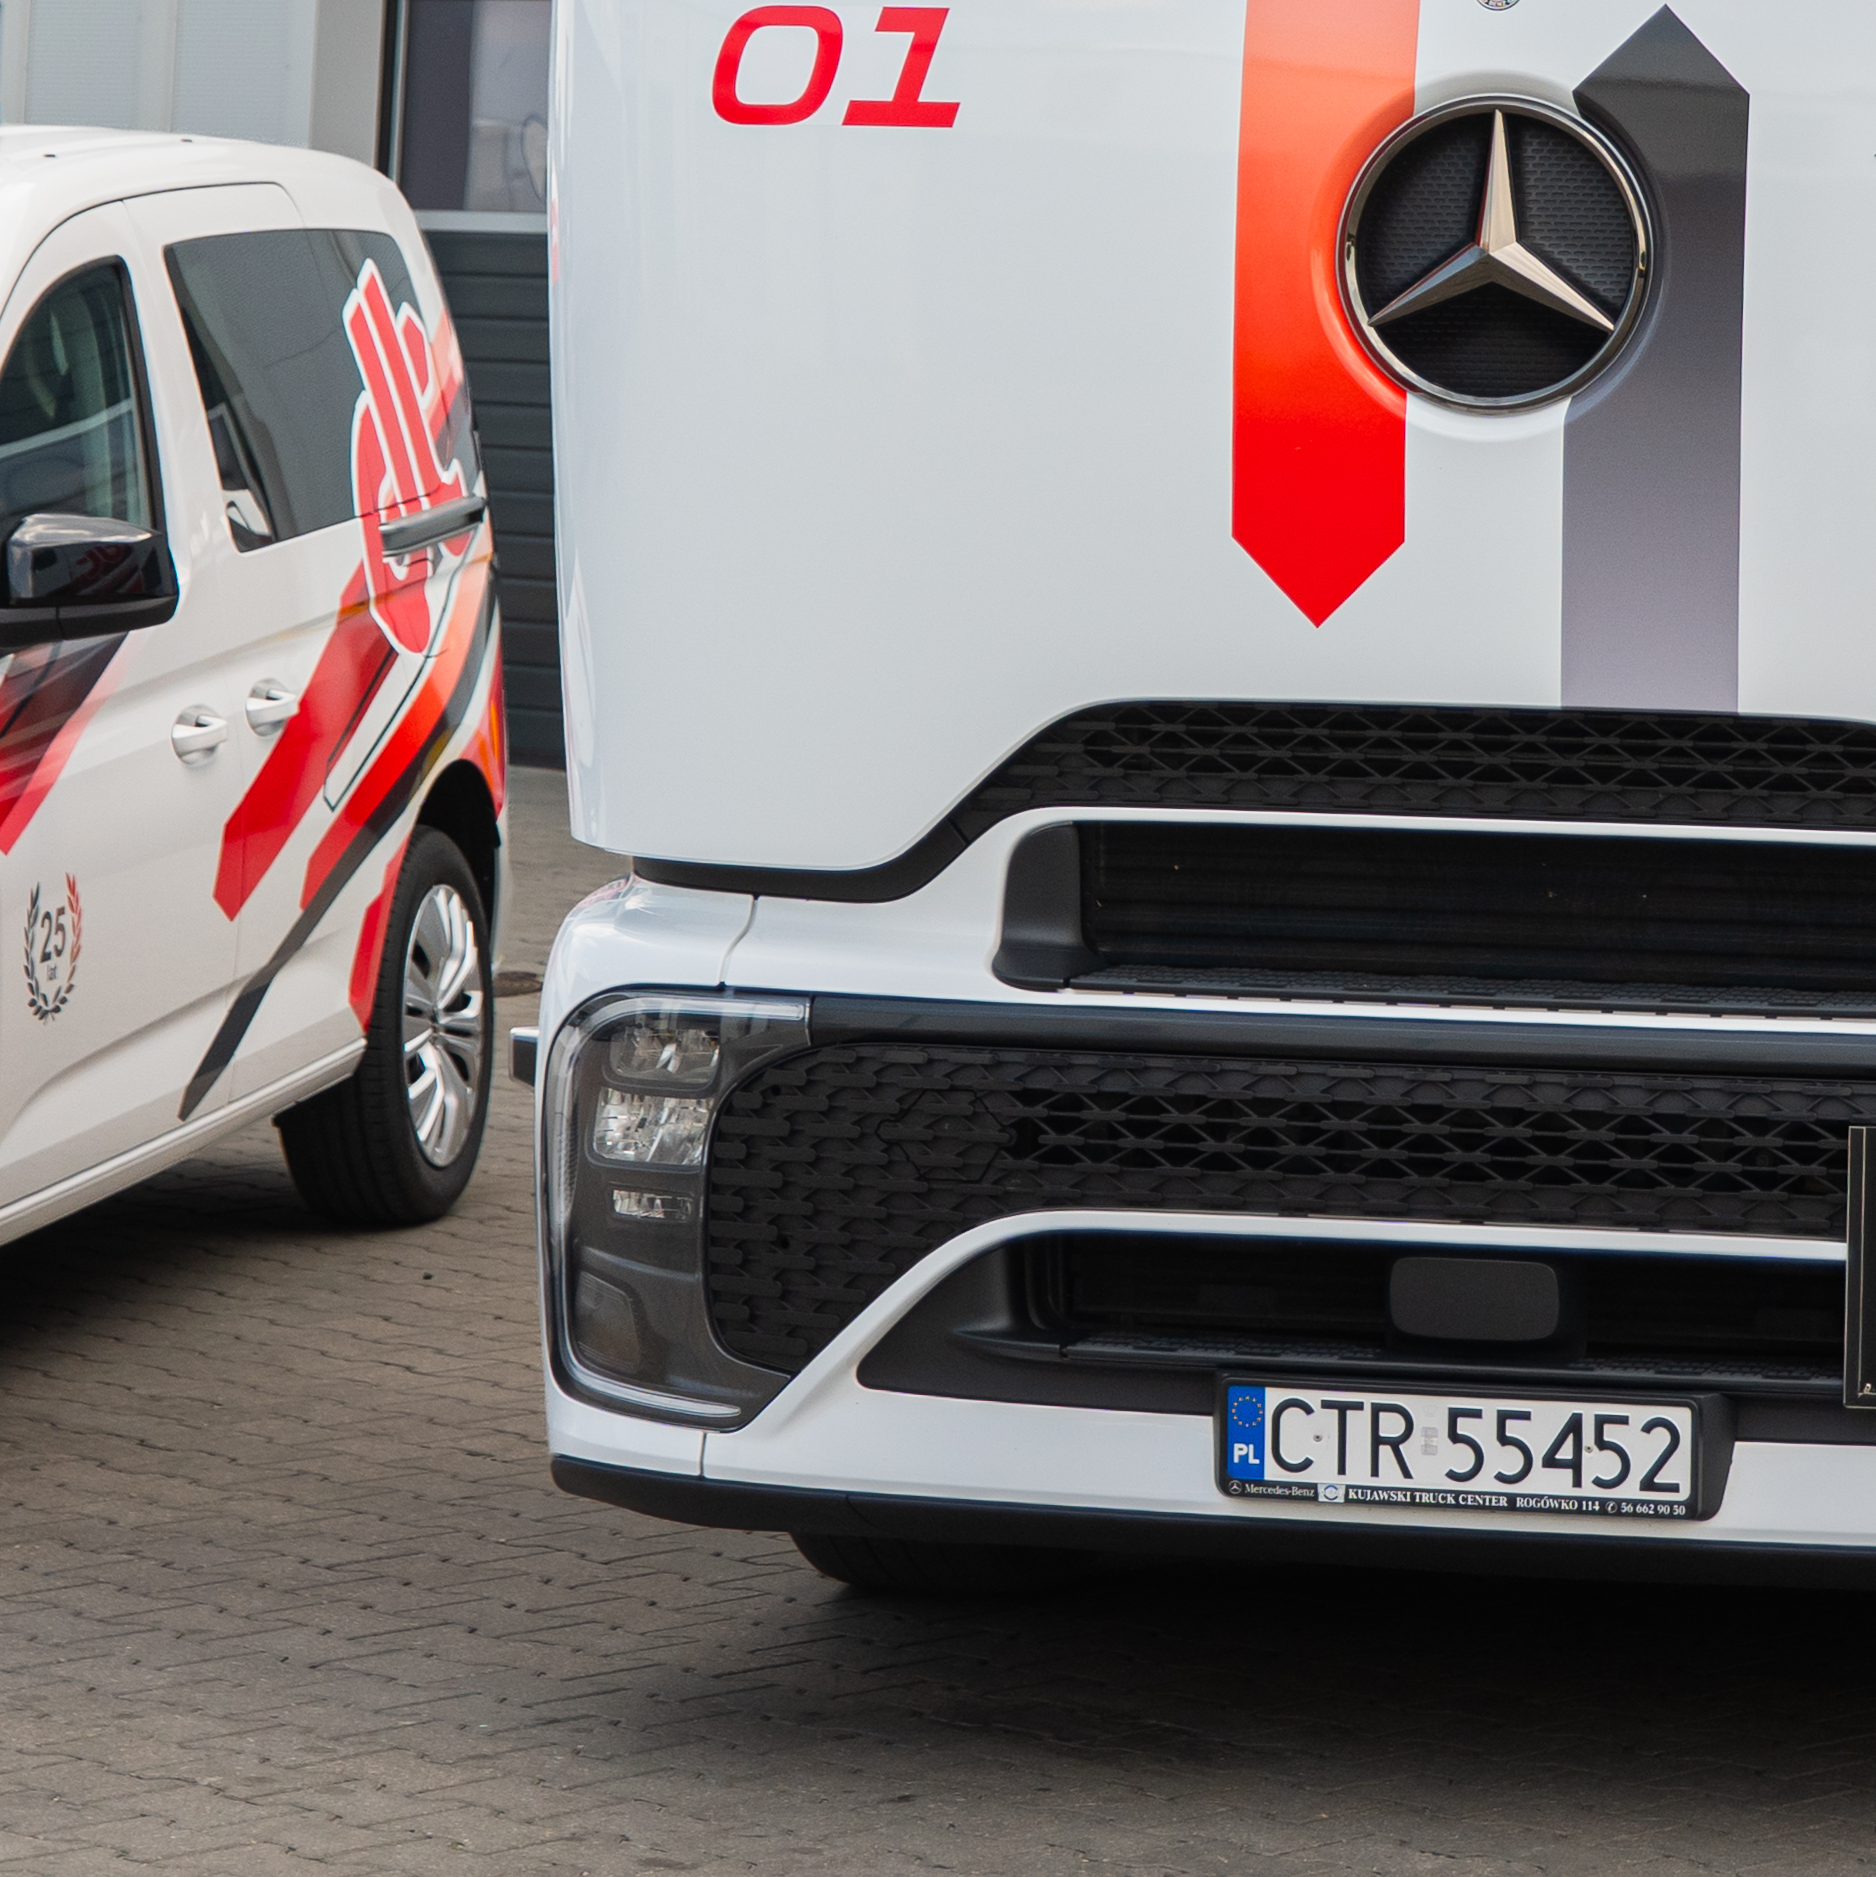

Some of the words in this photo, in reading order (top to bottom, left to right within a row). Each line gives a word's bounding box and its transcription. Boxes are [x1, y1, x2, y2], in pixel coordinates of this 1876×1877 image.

[711, 4, 962, 128] 01
[39, 906, 66, 964] 25
[1232, 1442, 1260, 1465] PL
[1271, 1396, 1414, 1480] CTR
[1444, 1406, 1681, 1494] 55452
[1244, 1482, 1315, 1497] Mercedes-Benz
[1348, 1488, 1411, 1503] KUJAWSKI
[1413, 1491, 1456, 1504] TRUCK
[1458, 1493, 1508, 1507] CENTER
[1516, 1495, 1579, 1510] ROGÓWKO
[1581, 1499, 1601, 1512] 114
[1620, 1501, 1634, 1513] 56
[1635, 1502, 1654, 1514] 662
[1657, 1503, 1670, 1515] 90
[1672, 1504, 1686, 1516] 50
